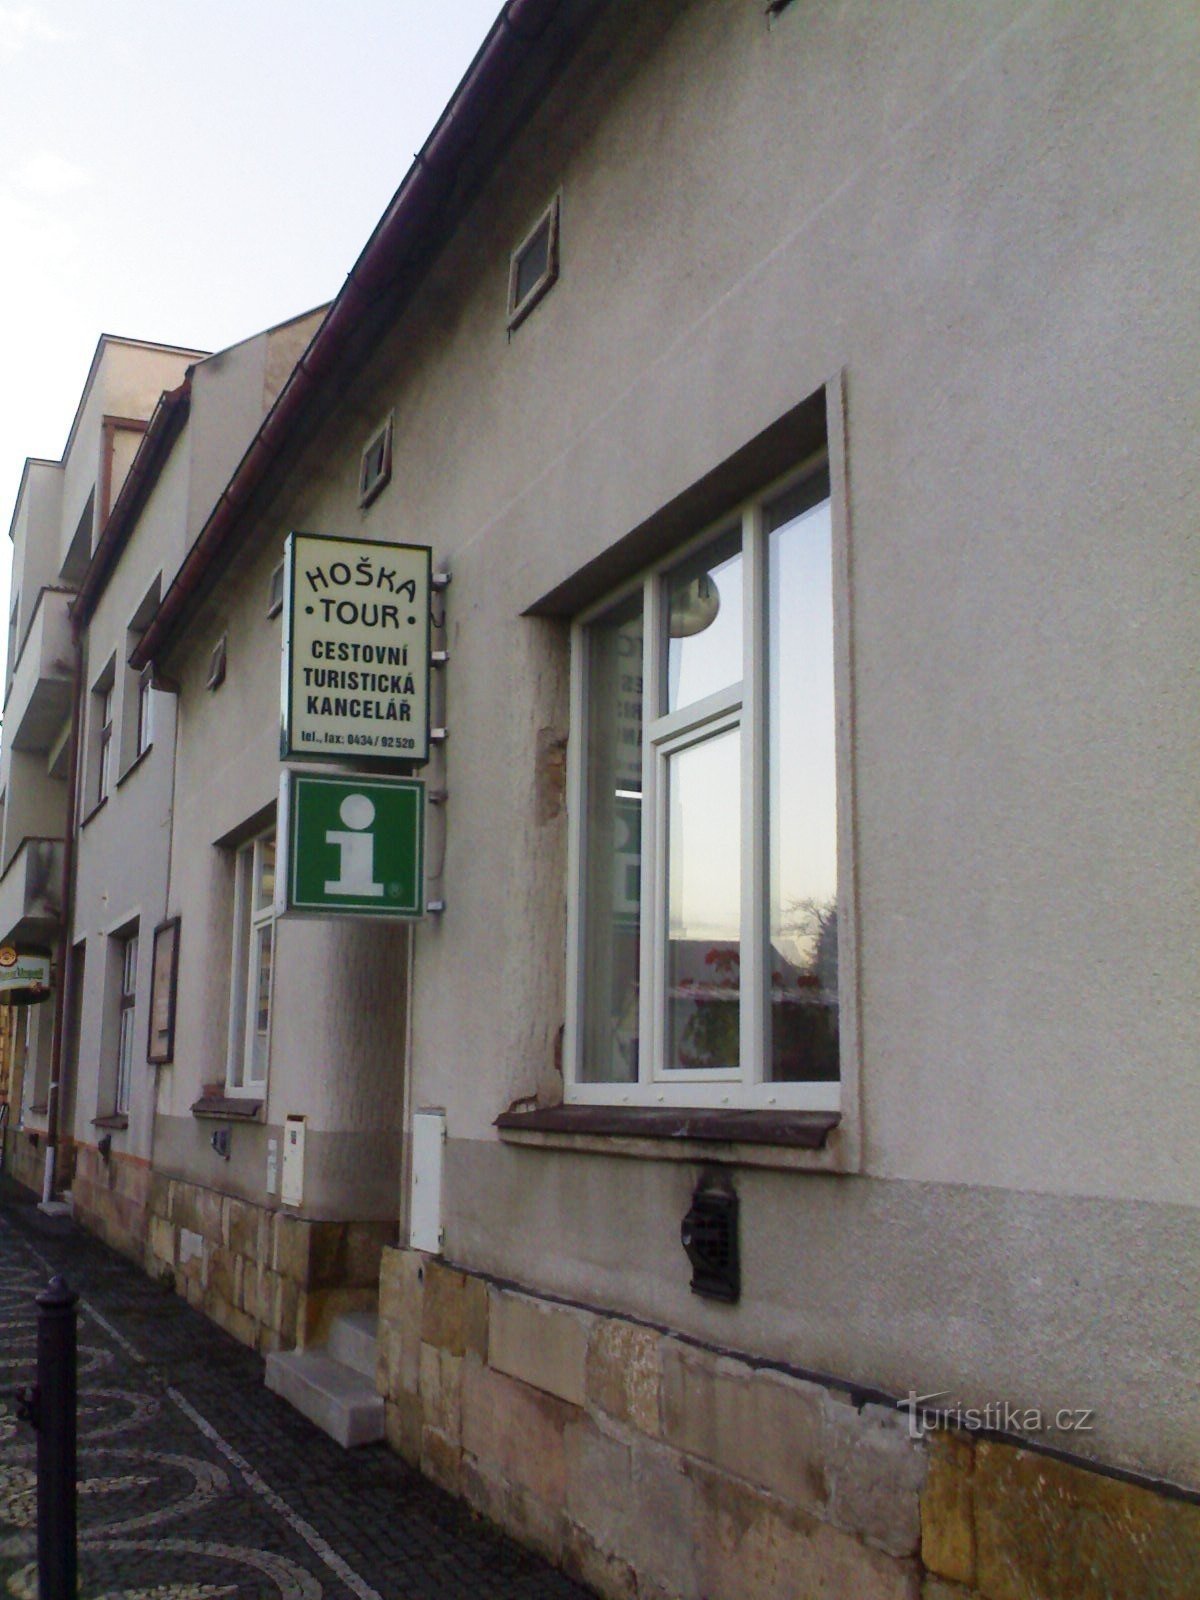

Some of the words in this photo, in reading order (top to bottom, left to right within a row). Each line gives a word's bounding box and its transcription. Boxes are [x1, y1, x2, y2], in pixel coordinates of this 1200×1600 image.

[306, 556, 416, 603] HOŠKA
[320, 598, 399, 629] TOUR
[312, 640, 408, 666] CESTOVNÍ
[303, 667, 415, 695] TURISTICKÁ
[307, 695, 411, 722] KANCELÁŘ
